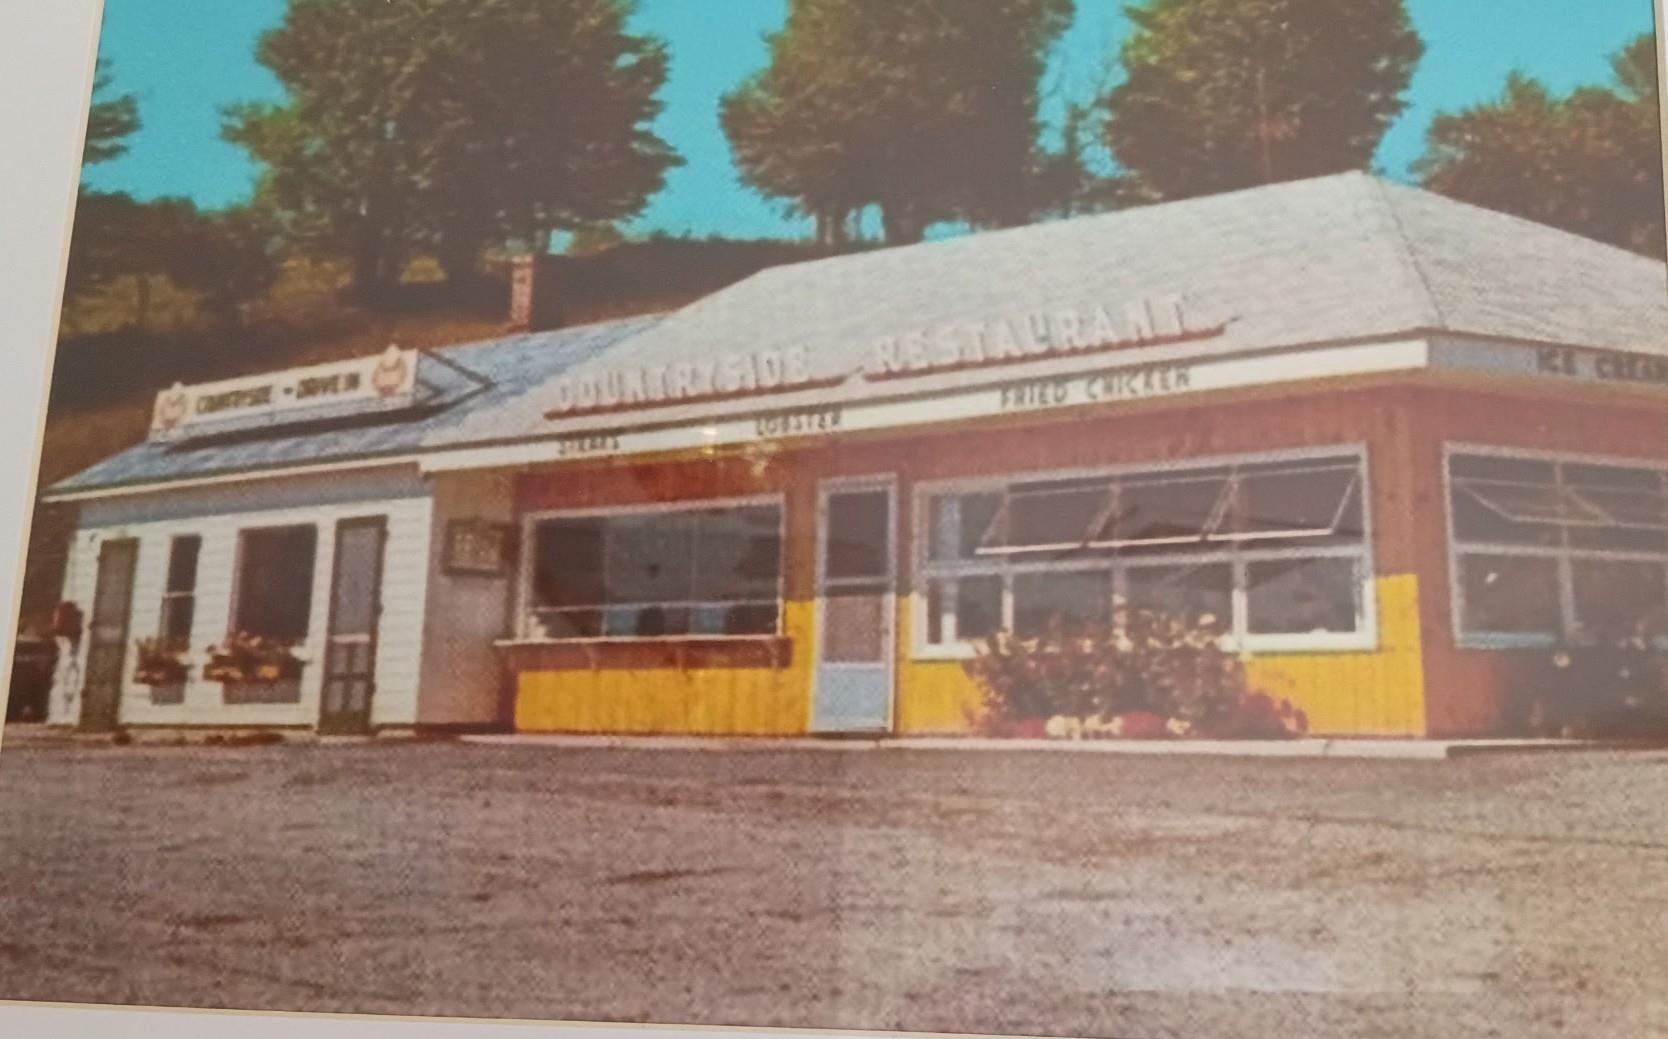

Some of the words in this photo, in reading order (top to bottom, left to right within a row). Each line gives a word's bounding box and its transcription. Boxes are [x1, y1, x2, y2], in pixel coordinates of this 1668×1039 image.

[874, 293, 1187, 372] RESTAURANT
[1001, 380, 1069, 408] FRIED
[1085, 366, 1192, 400] CHICKEN
[756, 408, 843, 435] LOBSTER
